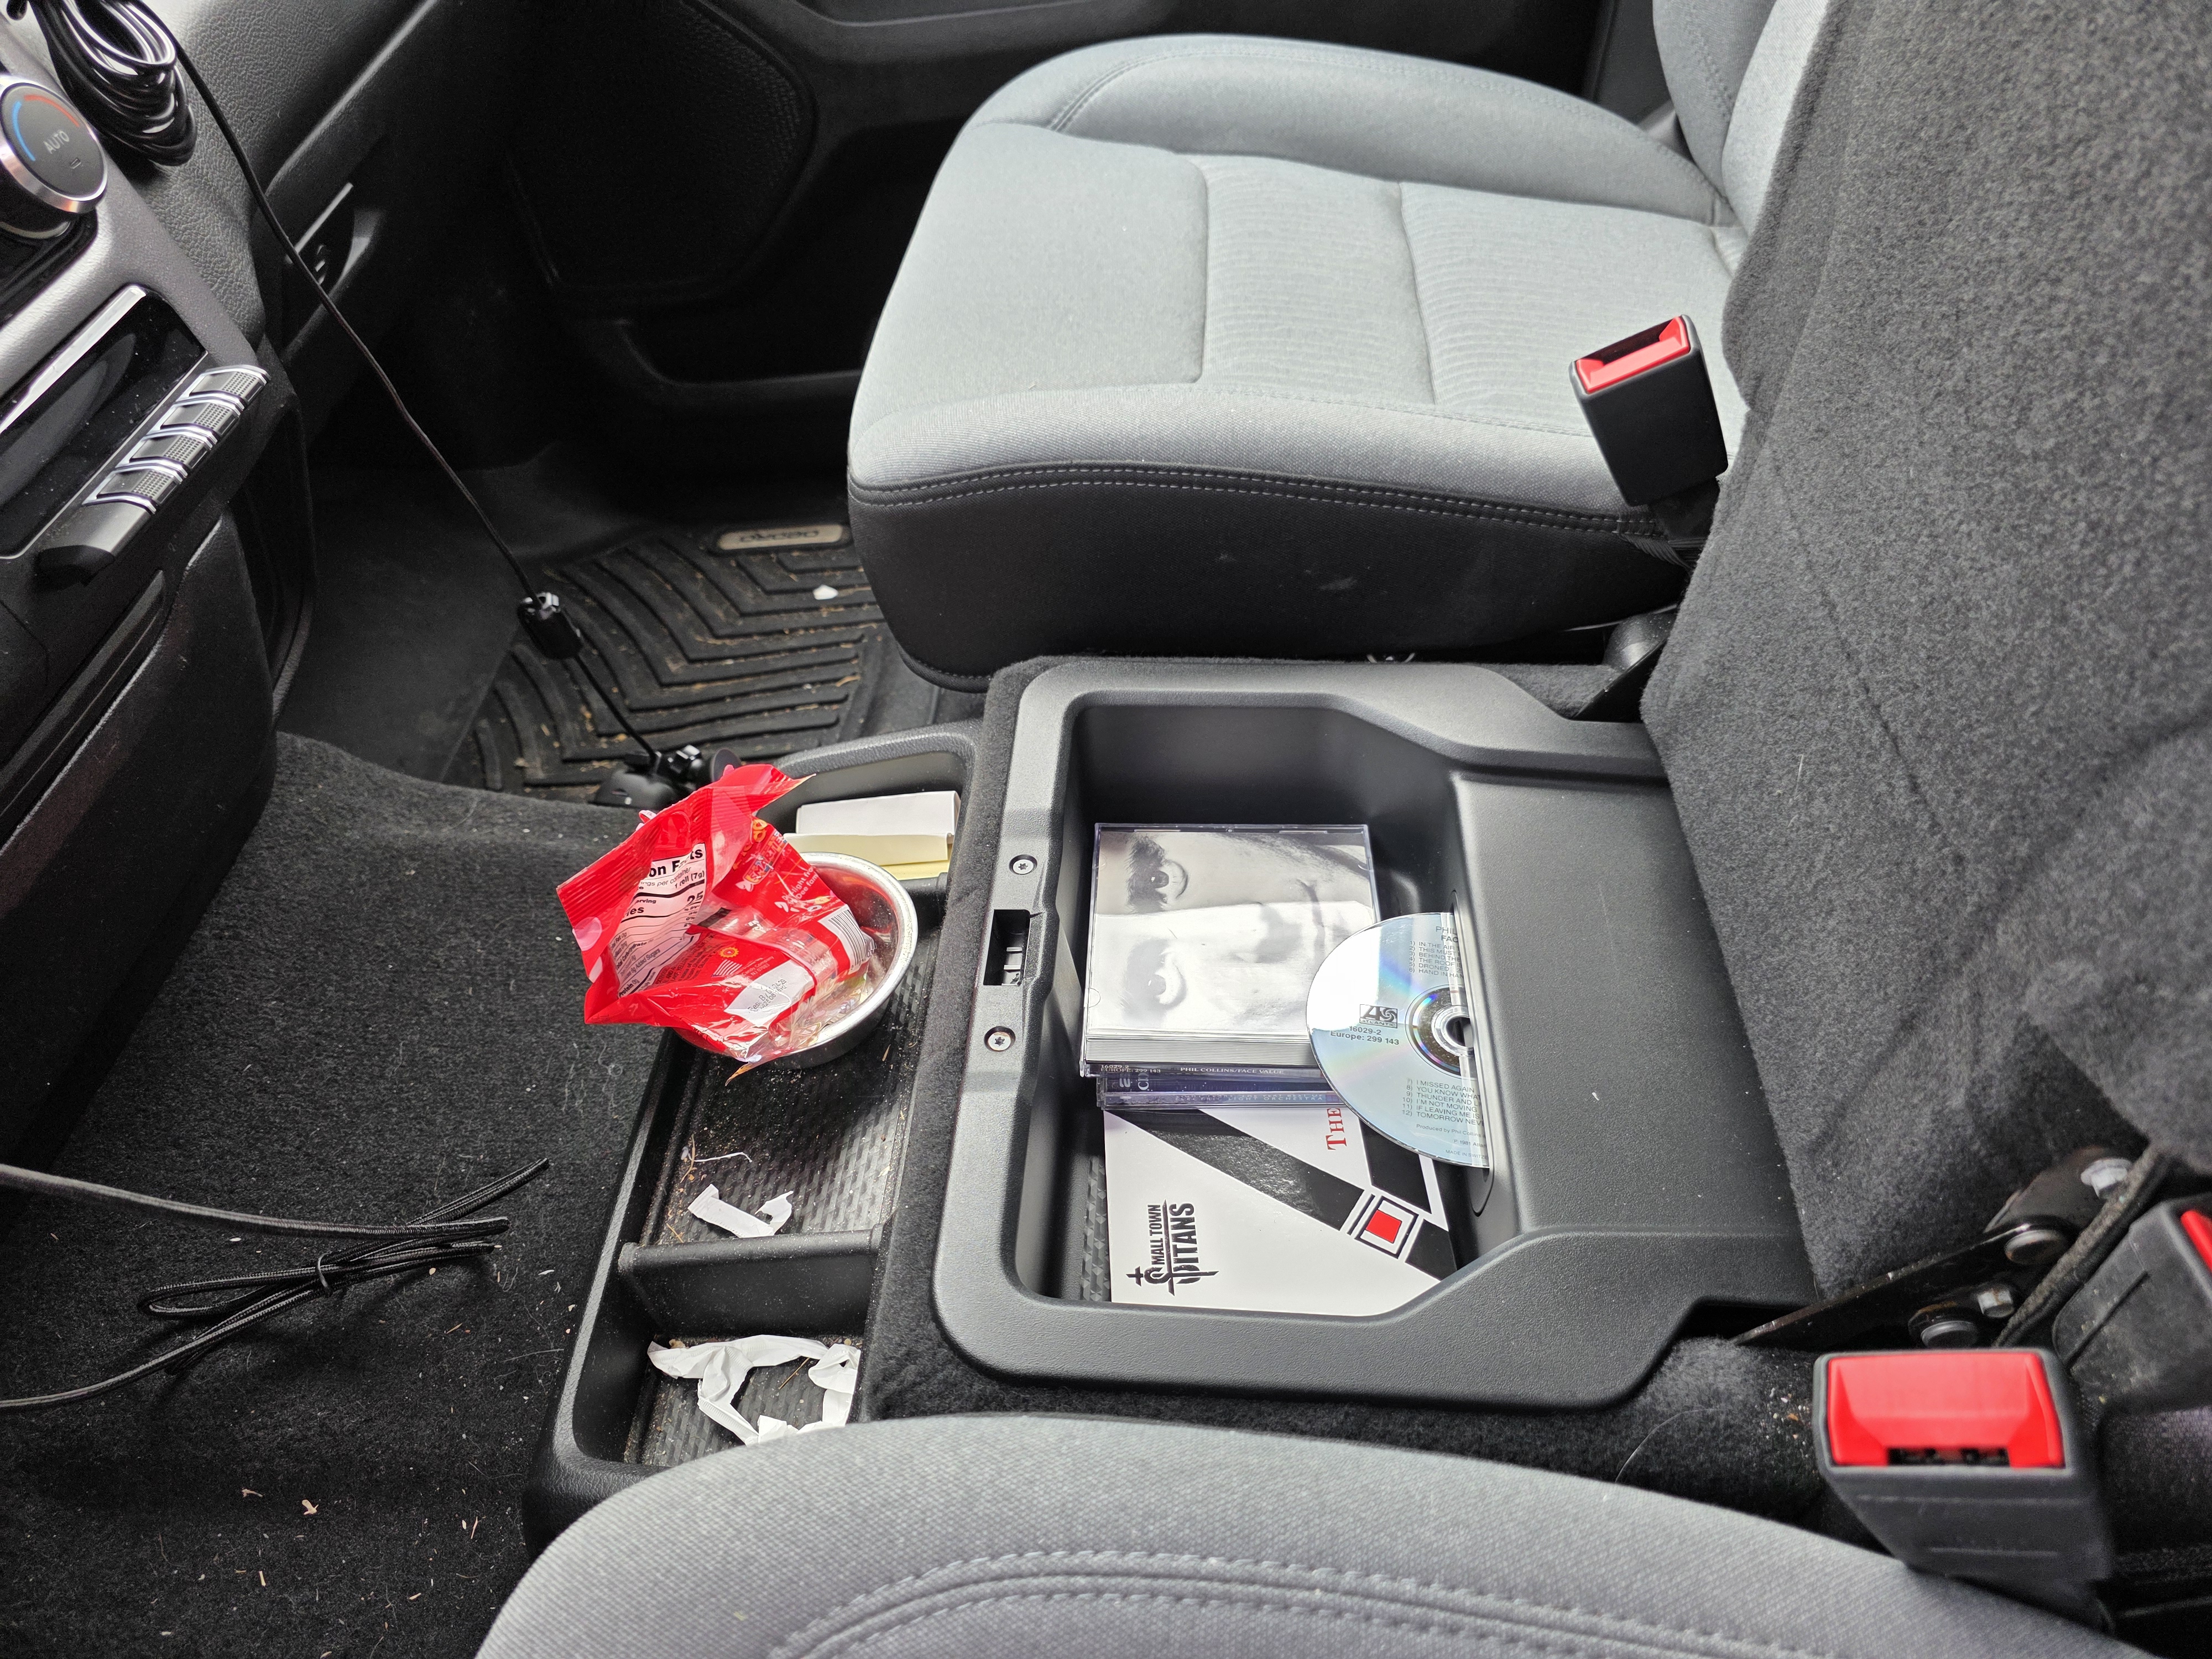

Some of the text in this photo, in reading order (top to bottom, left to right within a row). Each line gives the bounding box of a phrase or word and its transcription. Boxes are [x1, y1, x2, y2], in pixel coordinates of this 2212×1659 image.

[43, 130, 69, 154] AUTO
[670, 867, 691, 884] container
[679, 875, 689, 886] roll
[691, 870, 705, 881] (7g)
[687, 890, 703, 905] 25
[1436, 926, 1458, 935] PHIL
[636, 958, 647, 968] Added
[646, 948, 661, 961] Sugars
[1418, 952, 1446, 960] BEHIND
[1418, 963, 1449, 972] DRONED
[618, 982, 634, 998] Protein
[1330, 1030, 1364, 1041] Europe:
[1349, 1026, 1381, 1035] 16029-2
[1420, 1080, 1449, 1089] MISSED
[1451, 1084, 1474, 1093] AGAIN
[1417, 1092, 1454, 1103] THUNDER
[1434, 1089, 1458, 1098] KNOW
[1460, 1092, 1480, 1100] WHAT
[1425, 1105, 1457, 1116] LEAVING
[1446, 1103, 1477, 1112] MOVING
[1417, 1111, 1463, 1123] TOMORROW
[1326, 1108, 1347, 1150] THE
[1416, 1124, 1442, 1132] Produced
[1144, 1204, 1170, 1284] SMALL TOWN
[1168, 1203, 1202, 1285] TITANS
